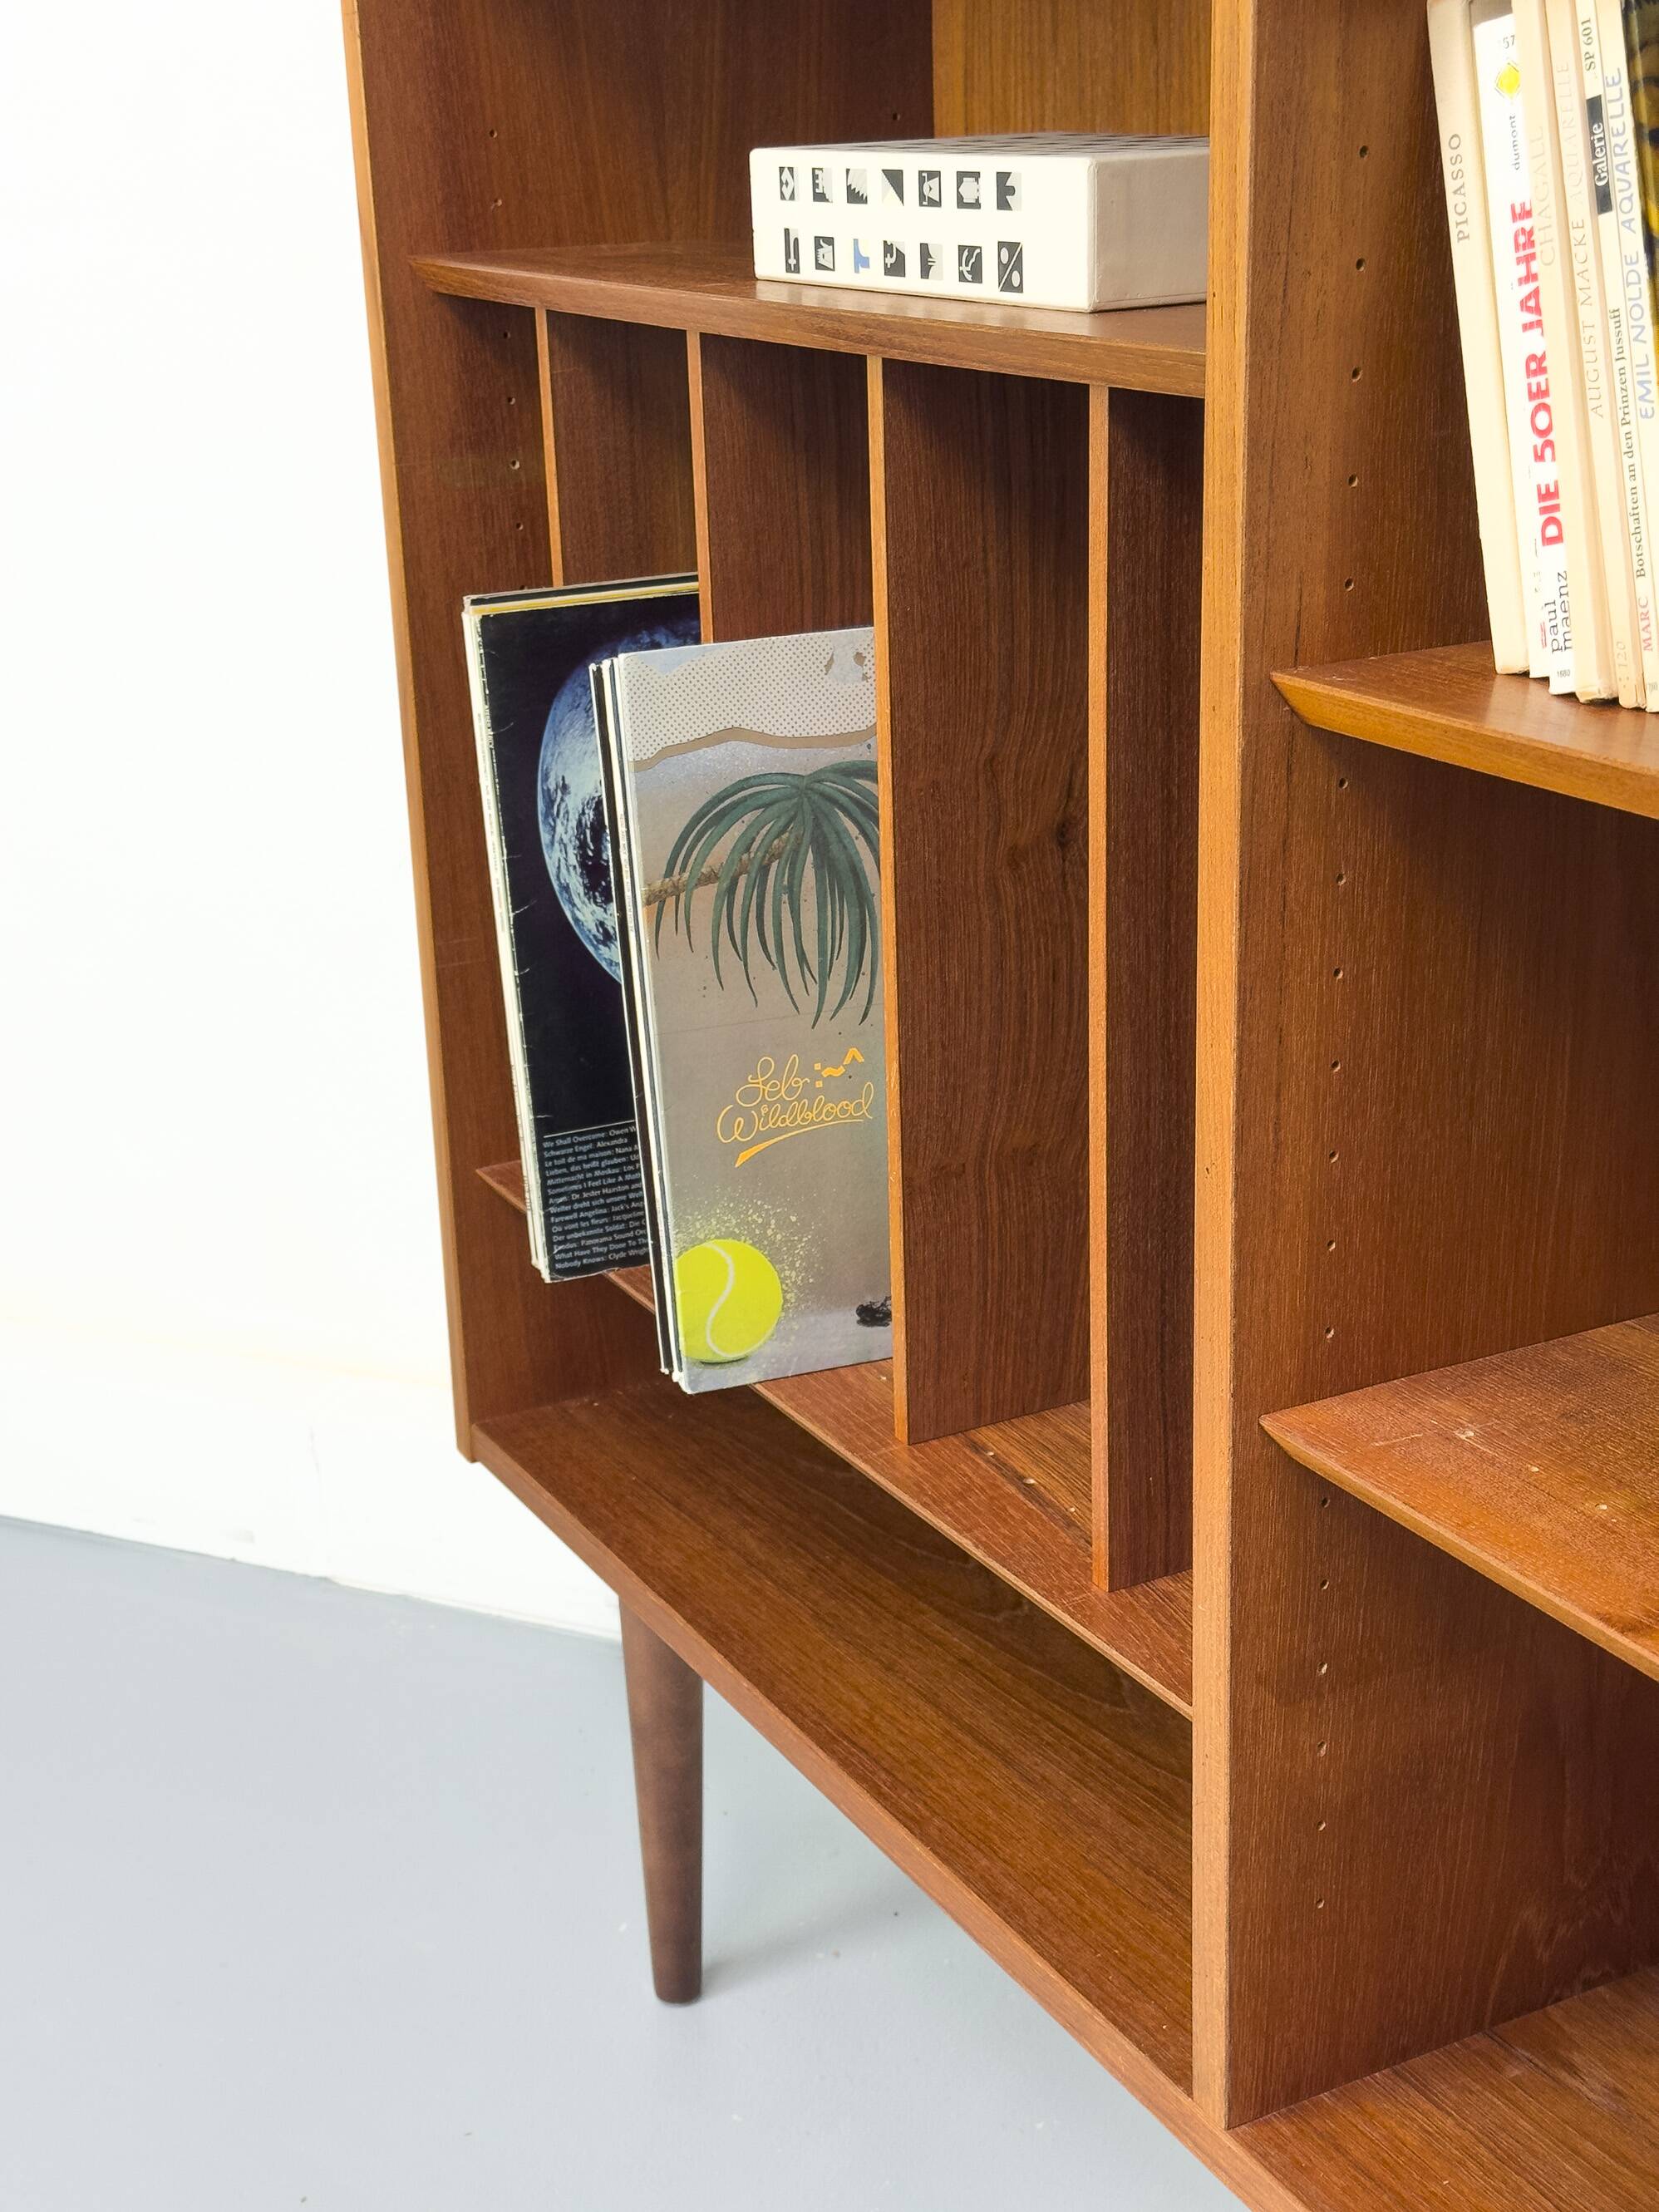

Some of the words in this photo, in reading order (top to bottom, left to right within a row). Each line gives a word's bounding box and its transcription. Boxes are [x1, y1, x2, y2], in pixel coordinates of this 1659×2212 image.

[1581, 17, 1593, 46] 601
[1583, 52, 1596, 71] SP
[1509, 114, 1521, 171] dumont
[1555, 61, 1584, 204] AQUARELLE
[1590, 122, 1608, 187] Galerie
[1605, 67, 1637, 234] AQUARELLE
[1448, 133, 1469, 243] PICASSO
[1529, 126, 1555, 267] CHAGALL
[1510, 199, 1543, 337] JAHRE
[1571, 219, 1593, 307] MACKE
[1624, 250, 1647, 344] NOLDE
[1582, 320, 1604, 418] AUGUST
[1618, 367, 1631, 426] Prinzen
[1636, 353, 1655, 419] EMIL
[1623, 431, 1634, 459] den
[1627, 464, 1637, 482] an
[1536, 480, 1563, 547] DIE
[1629, 486, 1647, 579] Botschaften
[1544, 599, 1563, 654] paul
[1558, 570, 1573, 651] maenz
[1638, 596, 1653, 652] MARC
[716, 1081, 874, 1144] Wildblood
